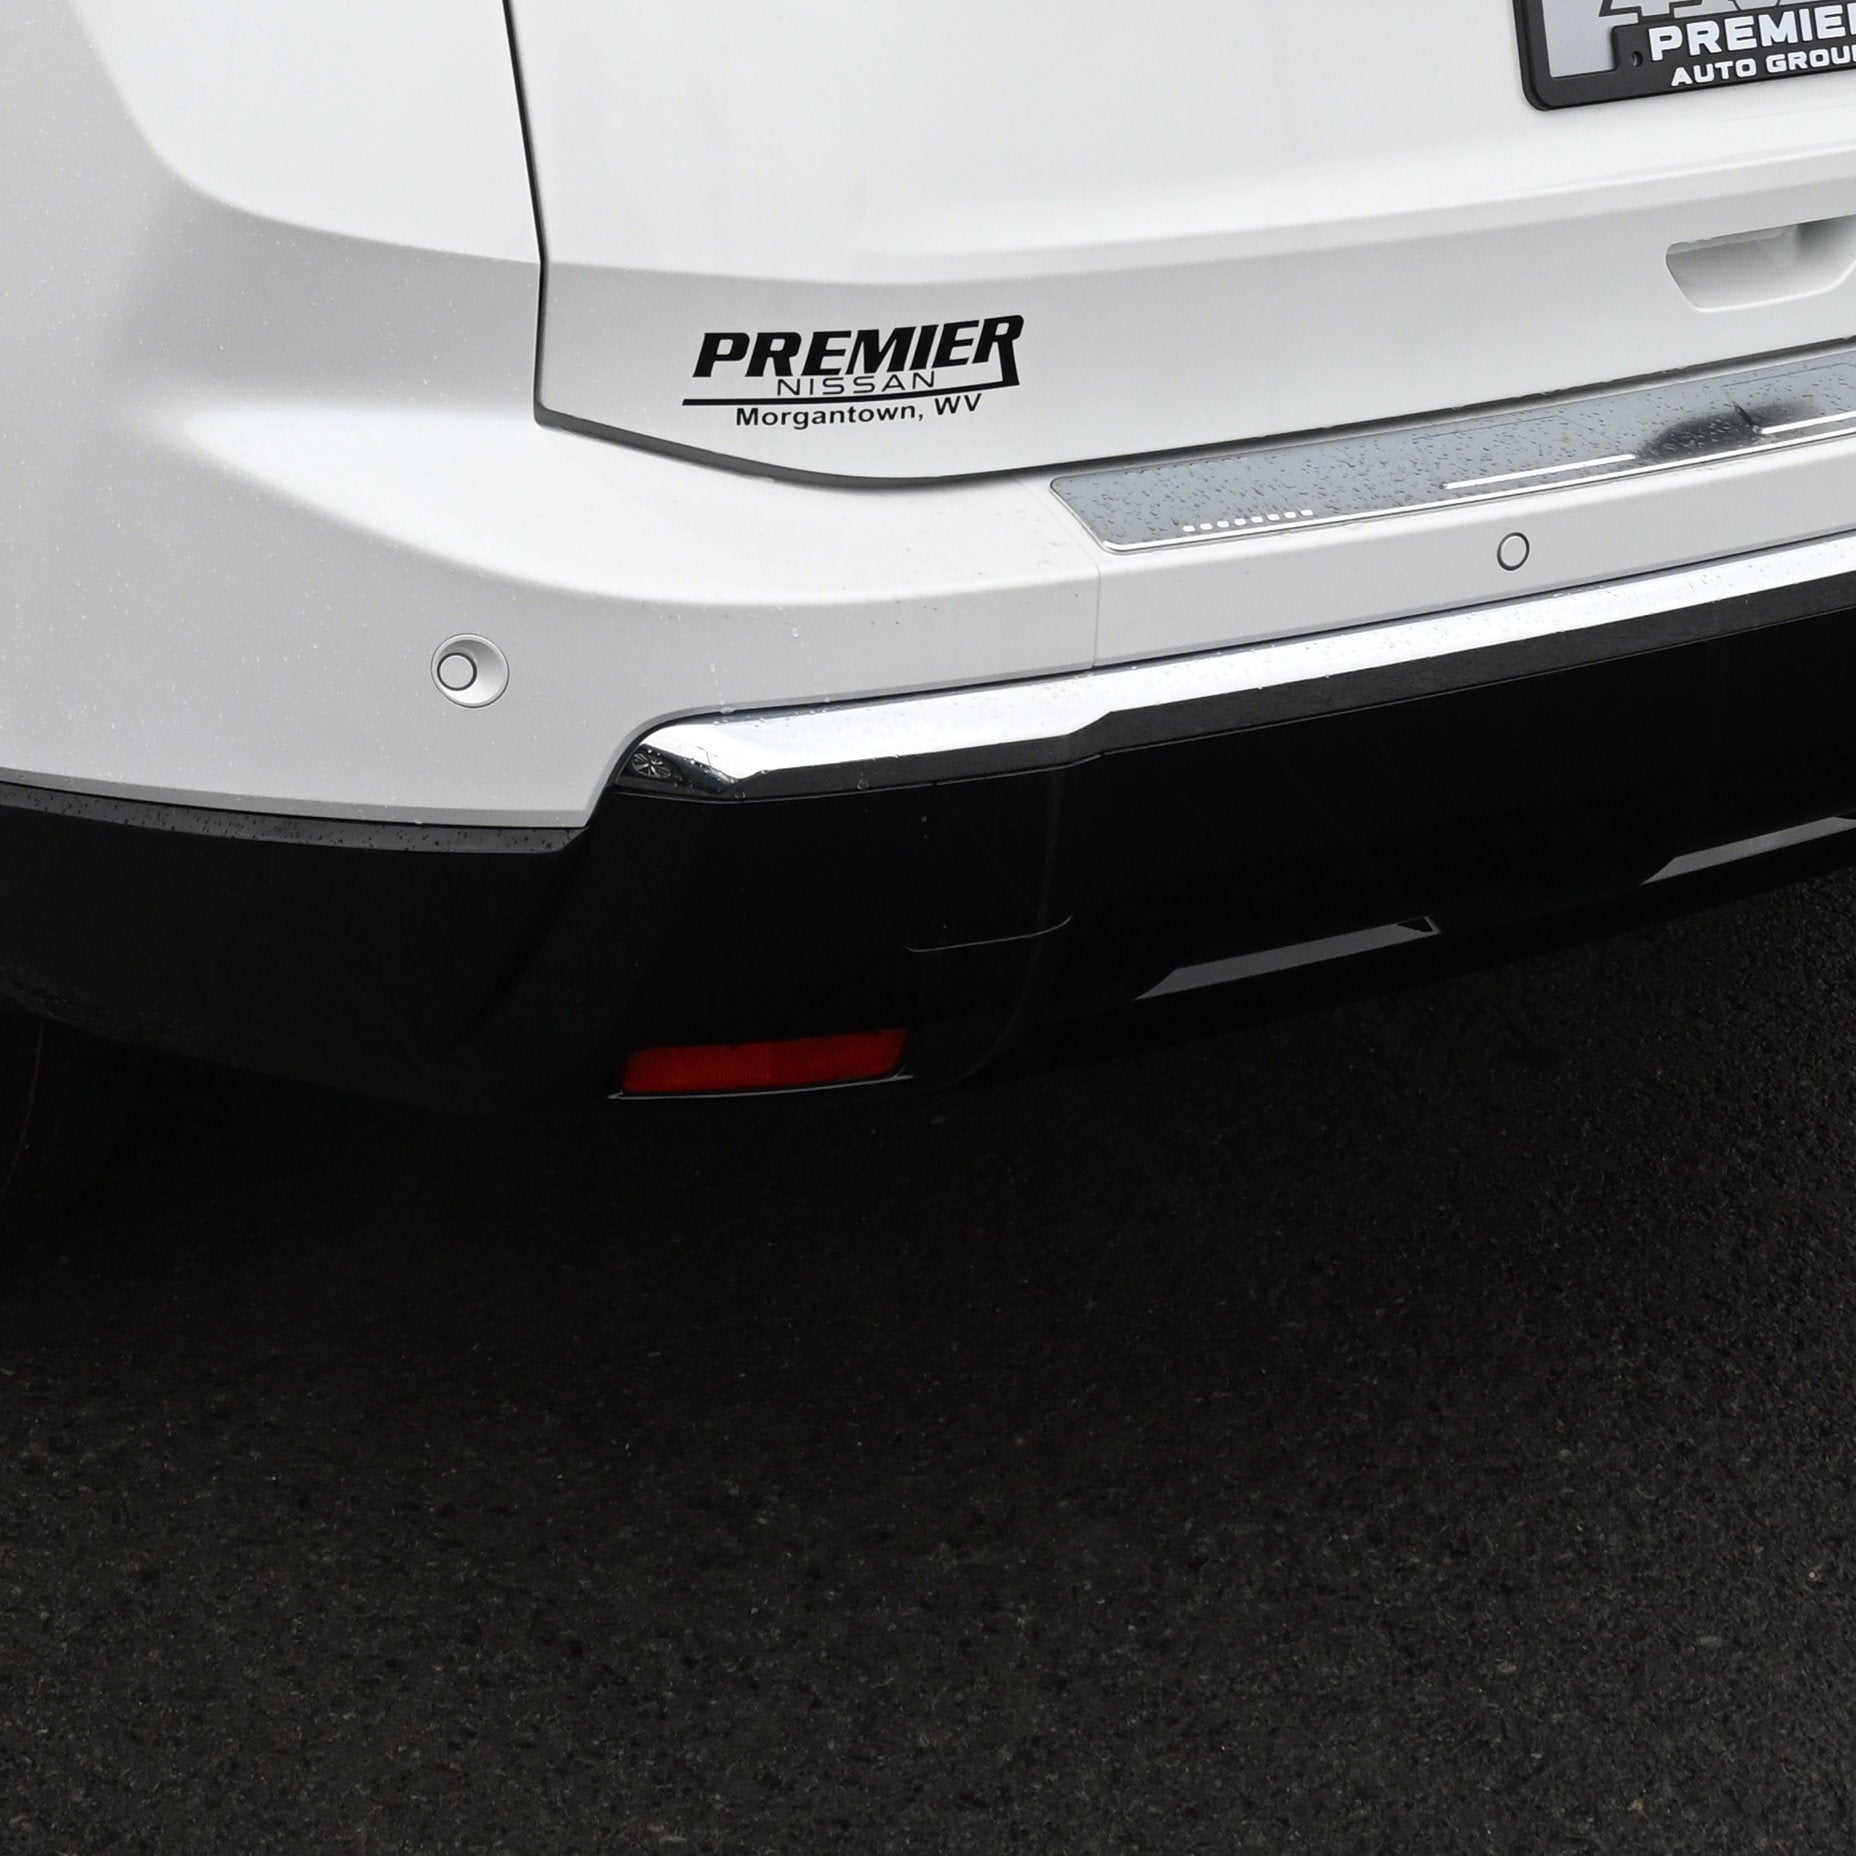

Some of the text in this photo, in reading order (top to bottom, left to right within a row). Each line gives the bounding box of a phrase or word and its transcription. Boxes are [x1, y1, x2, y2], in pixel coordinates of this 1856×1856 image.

[1670, 55, 1757, 87] AUTO
[692, 314, 1025, 385] PREMIER
[776, 370, 936, 397] NISSAN
[735, 393, 983, 431] Morgantown, WV
